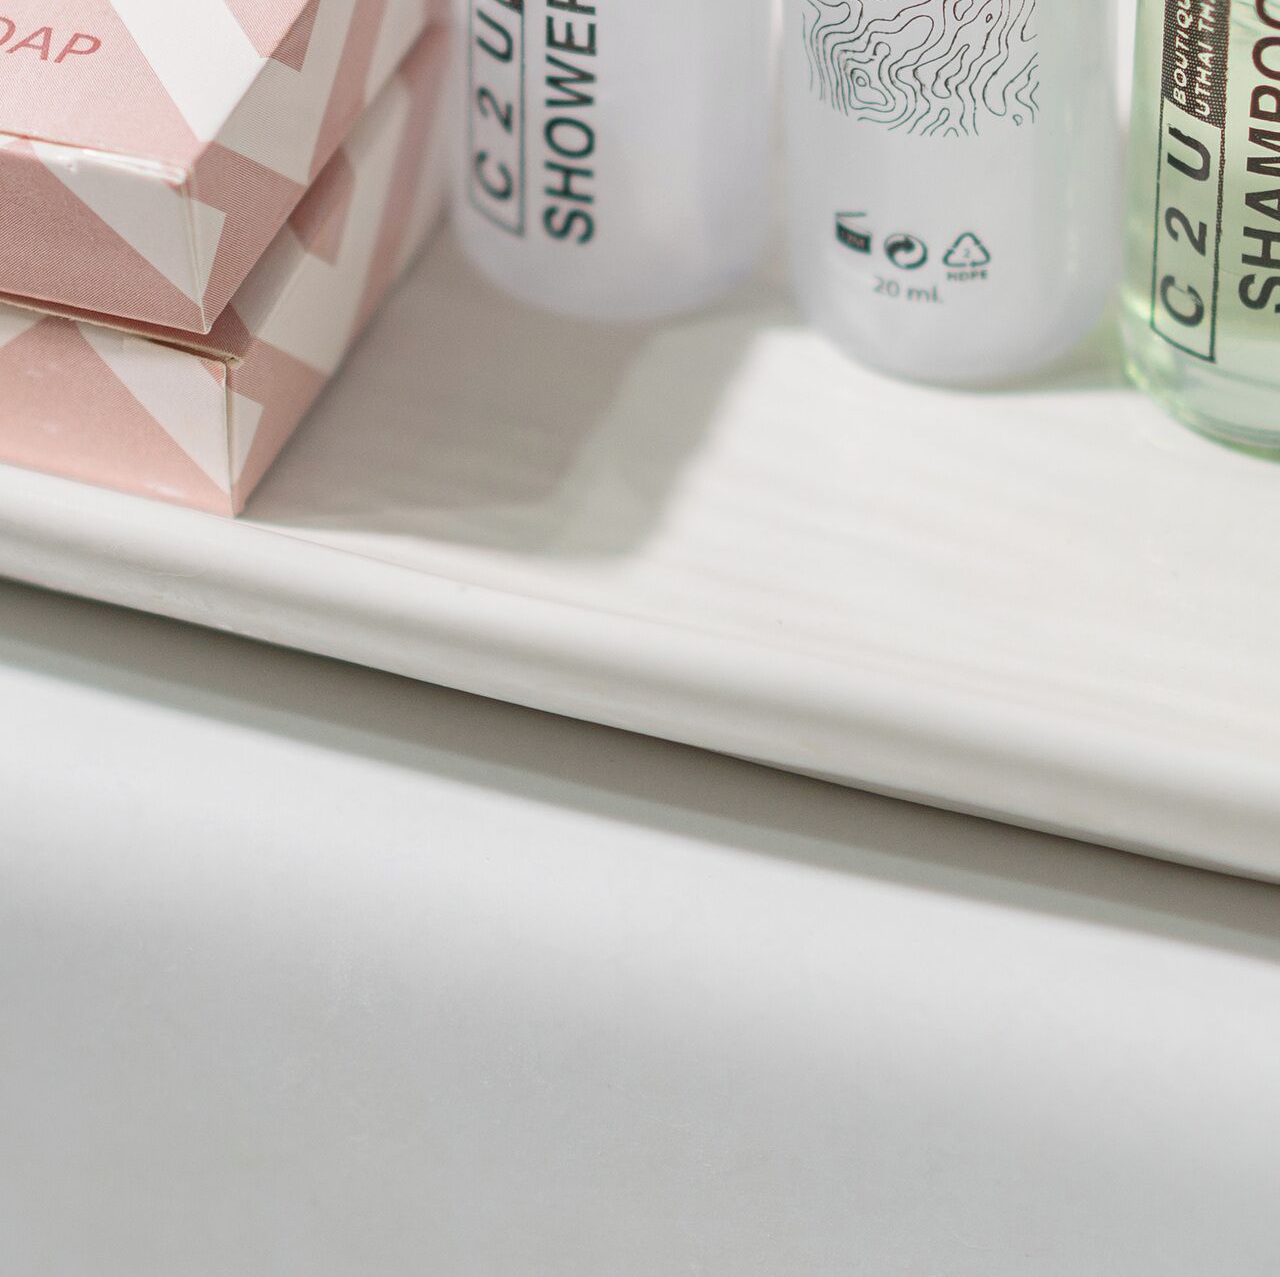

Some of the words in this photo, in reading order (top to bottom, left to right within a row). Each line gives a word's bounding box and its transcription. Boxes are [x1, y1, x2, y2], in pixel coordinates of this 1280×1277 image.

[1195, 42, 1214, 117] UTHAI
[873, 277, 900, 297] 20
[907, 286, 943, 303] ml.
